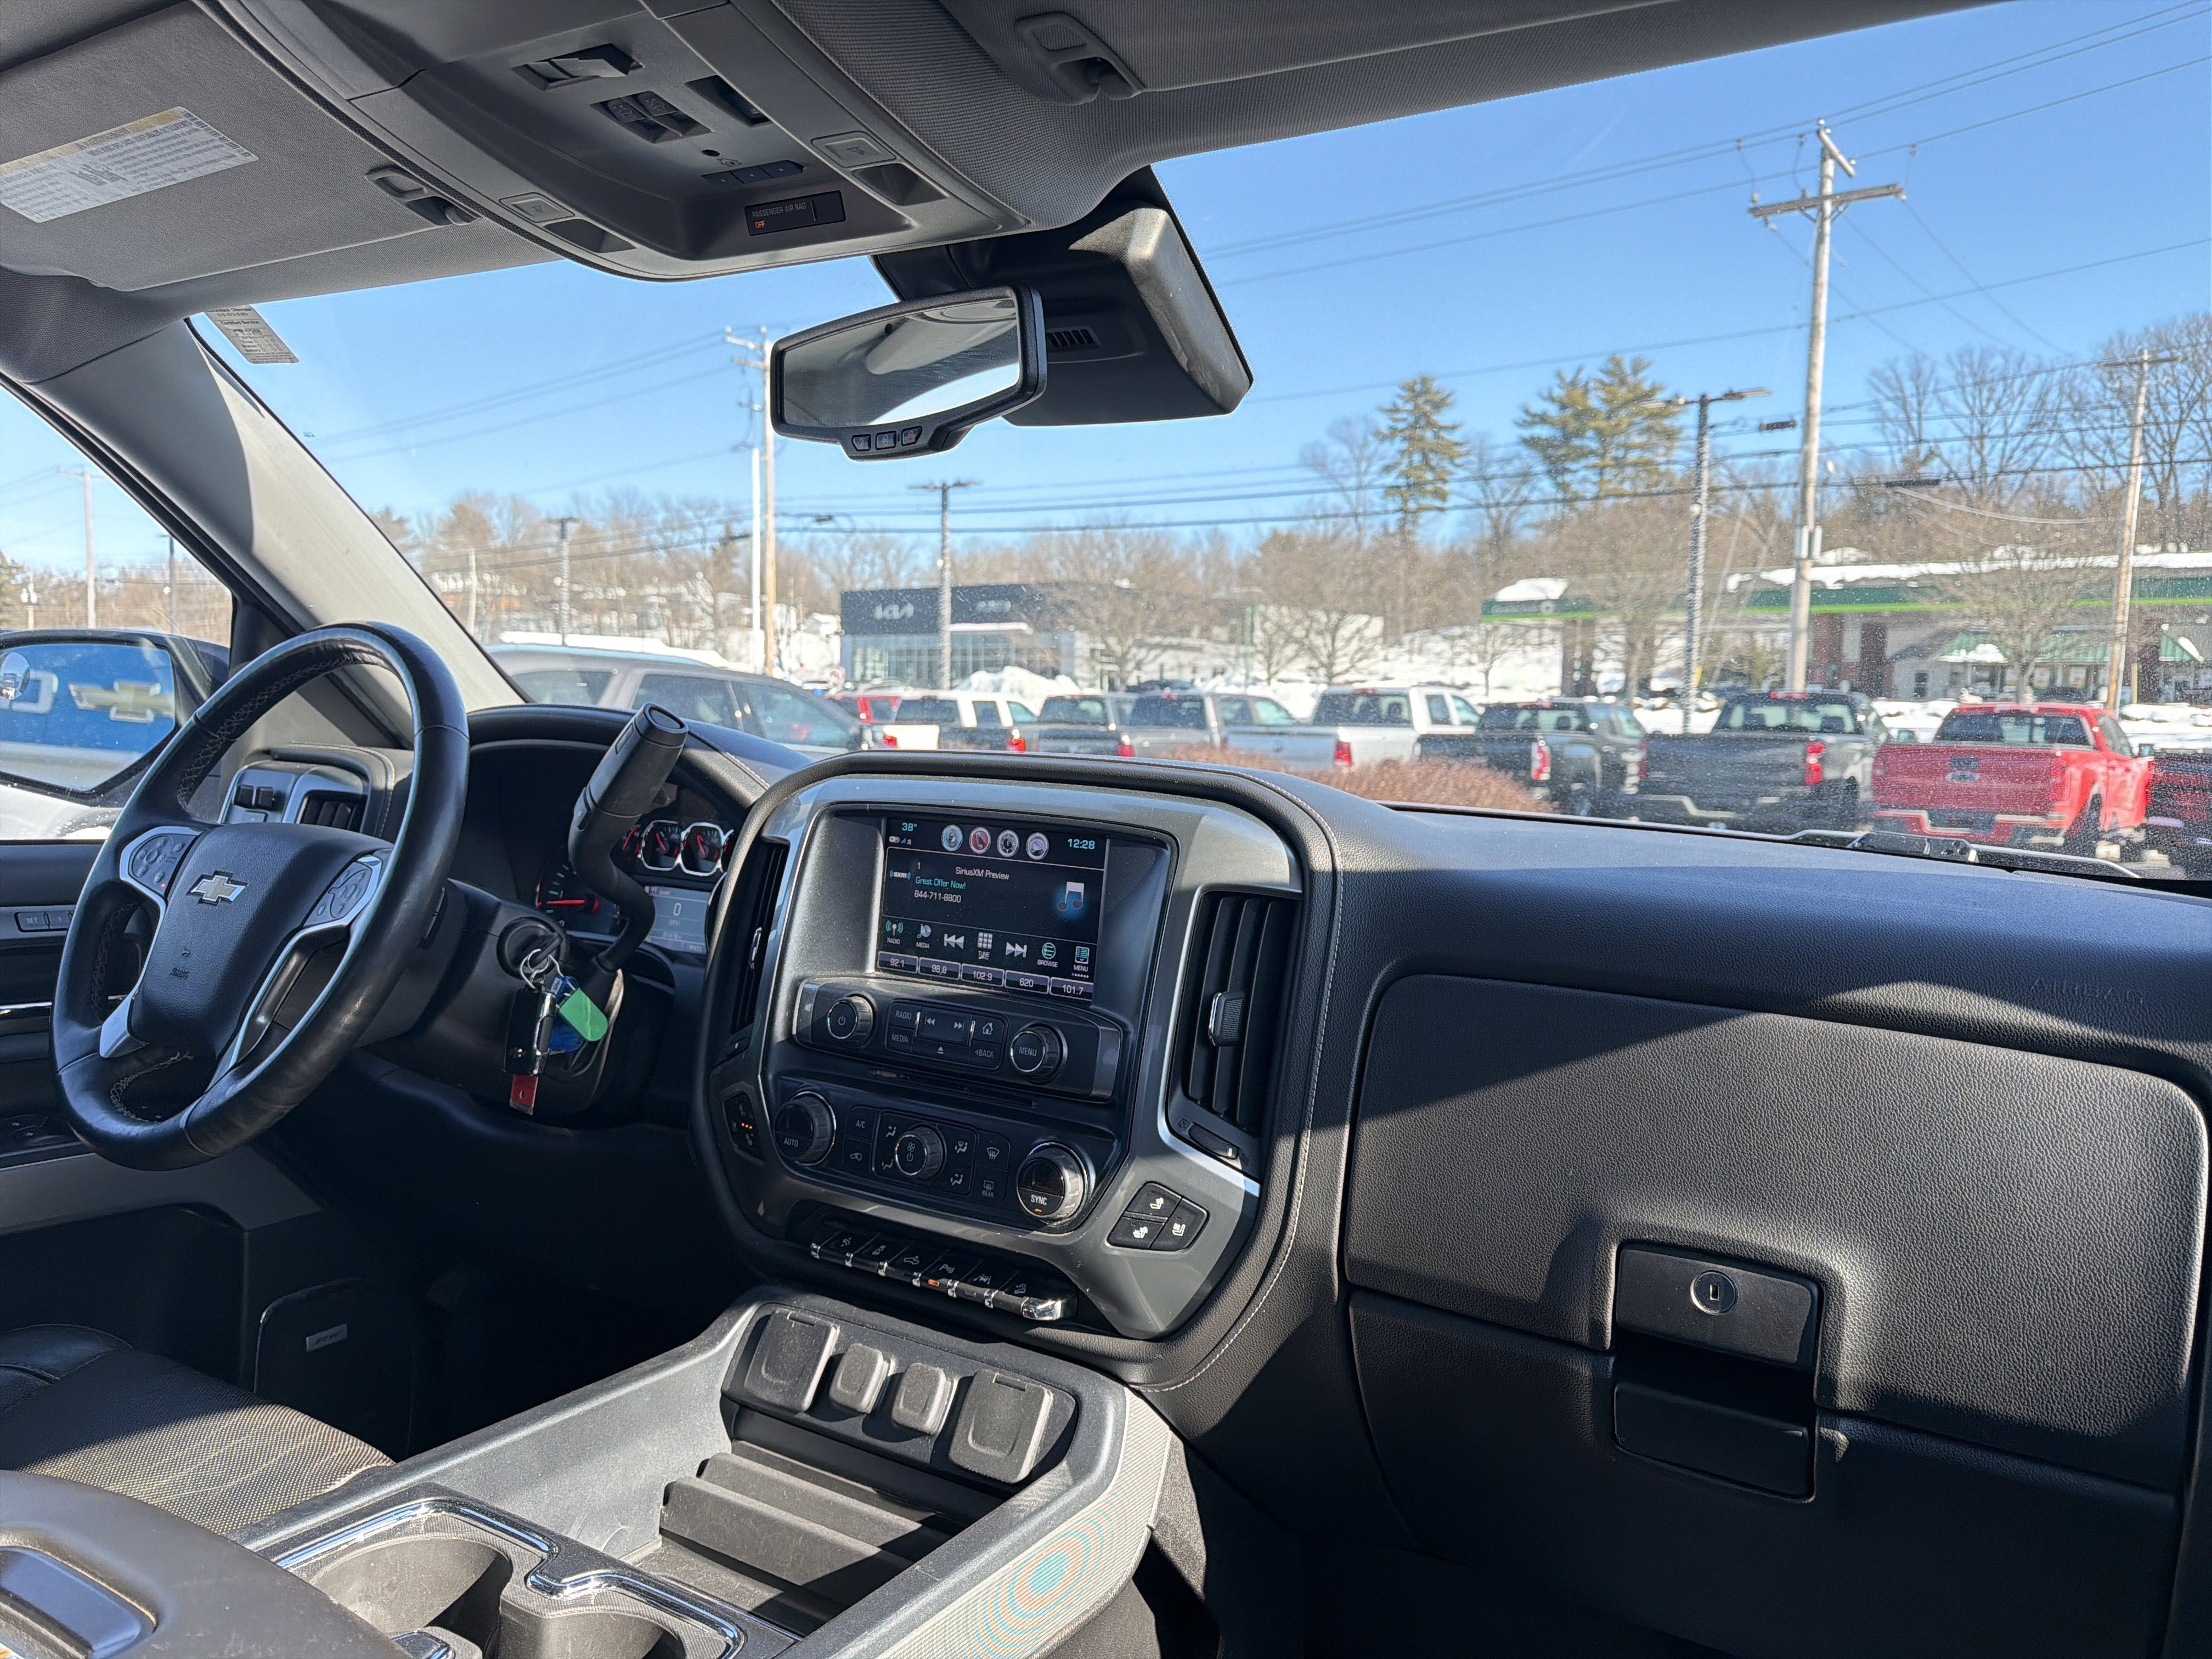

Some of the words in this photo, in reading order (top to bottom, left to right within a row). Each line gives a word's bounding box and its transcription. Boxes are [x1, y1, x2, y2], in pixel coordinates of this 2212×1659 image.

[752, 206, 784, 218] PASSENGER
[785, 204, 794, 212] AIR
[755, 220, 765, 229] OFF
[1067, 838, 1095, 850] 12:28
[955, 866, 984, 877] SiriusXM
[985, 869, 1010, 880] Preview
[915, 876, 933, 885] Great
[934, 878, 949, 887] Offer
[950, 881, 966, 889] Now!
[914, 889, 962, 903] 844-711-8800
[890, 958, 904, 968] 92.1
[1037, 959, 1058, 968] BROWSE
[1073, 964, 1088, 972] MENU
[973, 970, 992, 981] 102.9
[1019, 978, 1034, 988] 620
[1062, 984, 1084, 995] 101.7
[895, 1010, 912, 1020] RADIO
[891, 1033, 909, 1043] MEDIA
[979, 1048, 994, 1058] BACK
[1019, 1046, 1037, 1057] MENU
[855, 1119, 866, 1128] A/C
[783, 1137, 799, 1147] AUTO
[1030, 1194, 1047, 1206] SYNC
